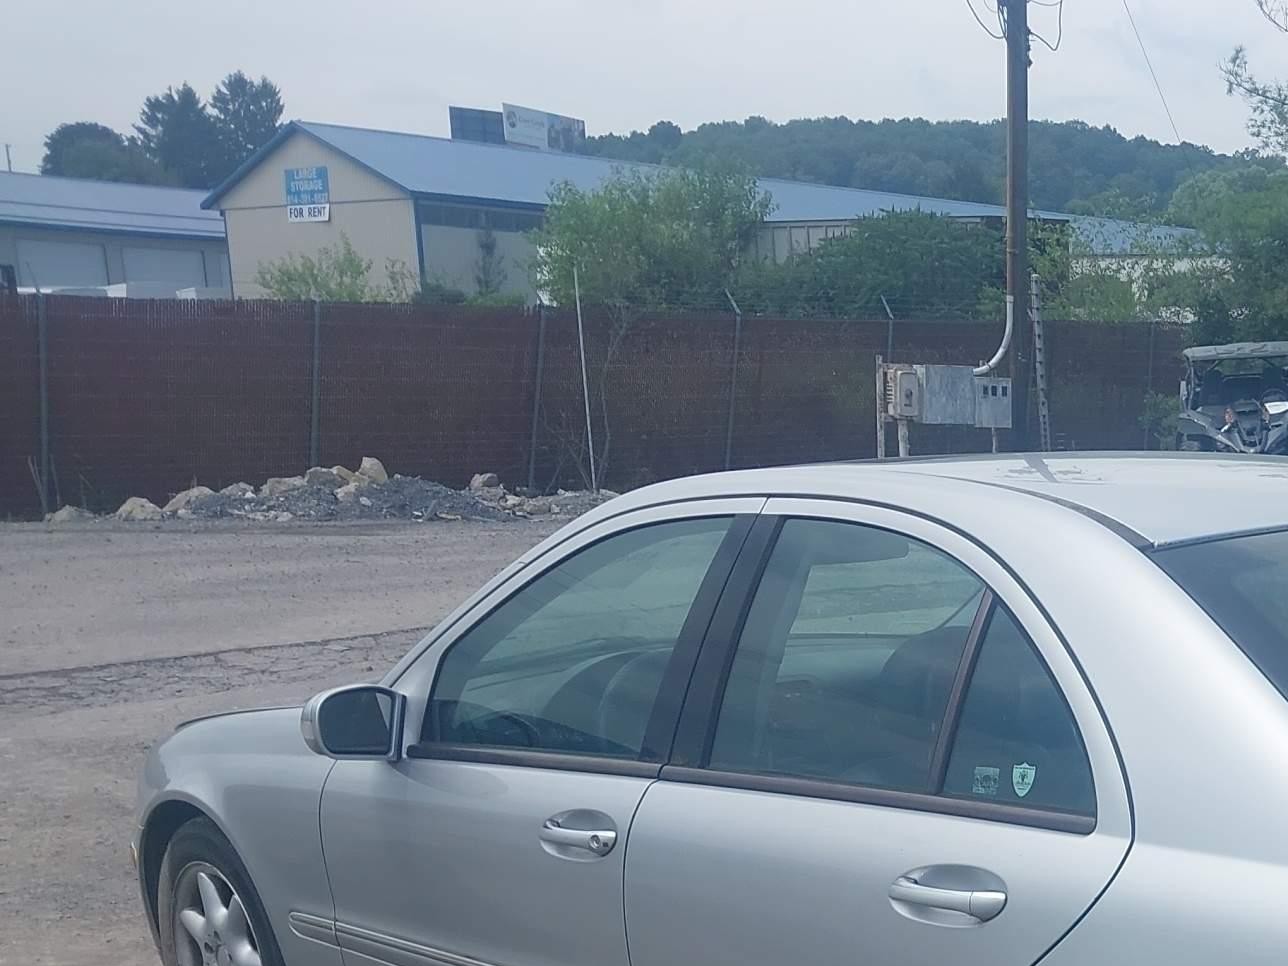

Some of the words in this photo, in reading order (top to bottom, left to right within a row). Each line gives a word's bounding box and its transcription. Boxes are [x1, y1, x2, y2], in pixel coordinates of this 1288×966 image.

[290, 179, 323, 192] STORAGE
[289, 207, 304, 219] FOR
[307, 206, 326, 217] RENT
